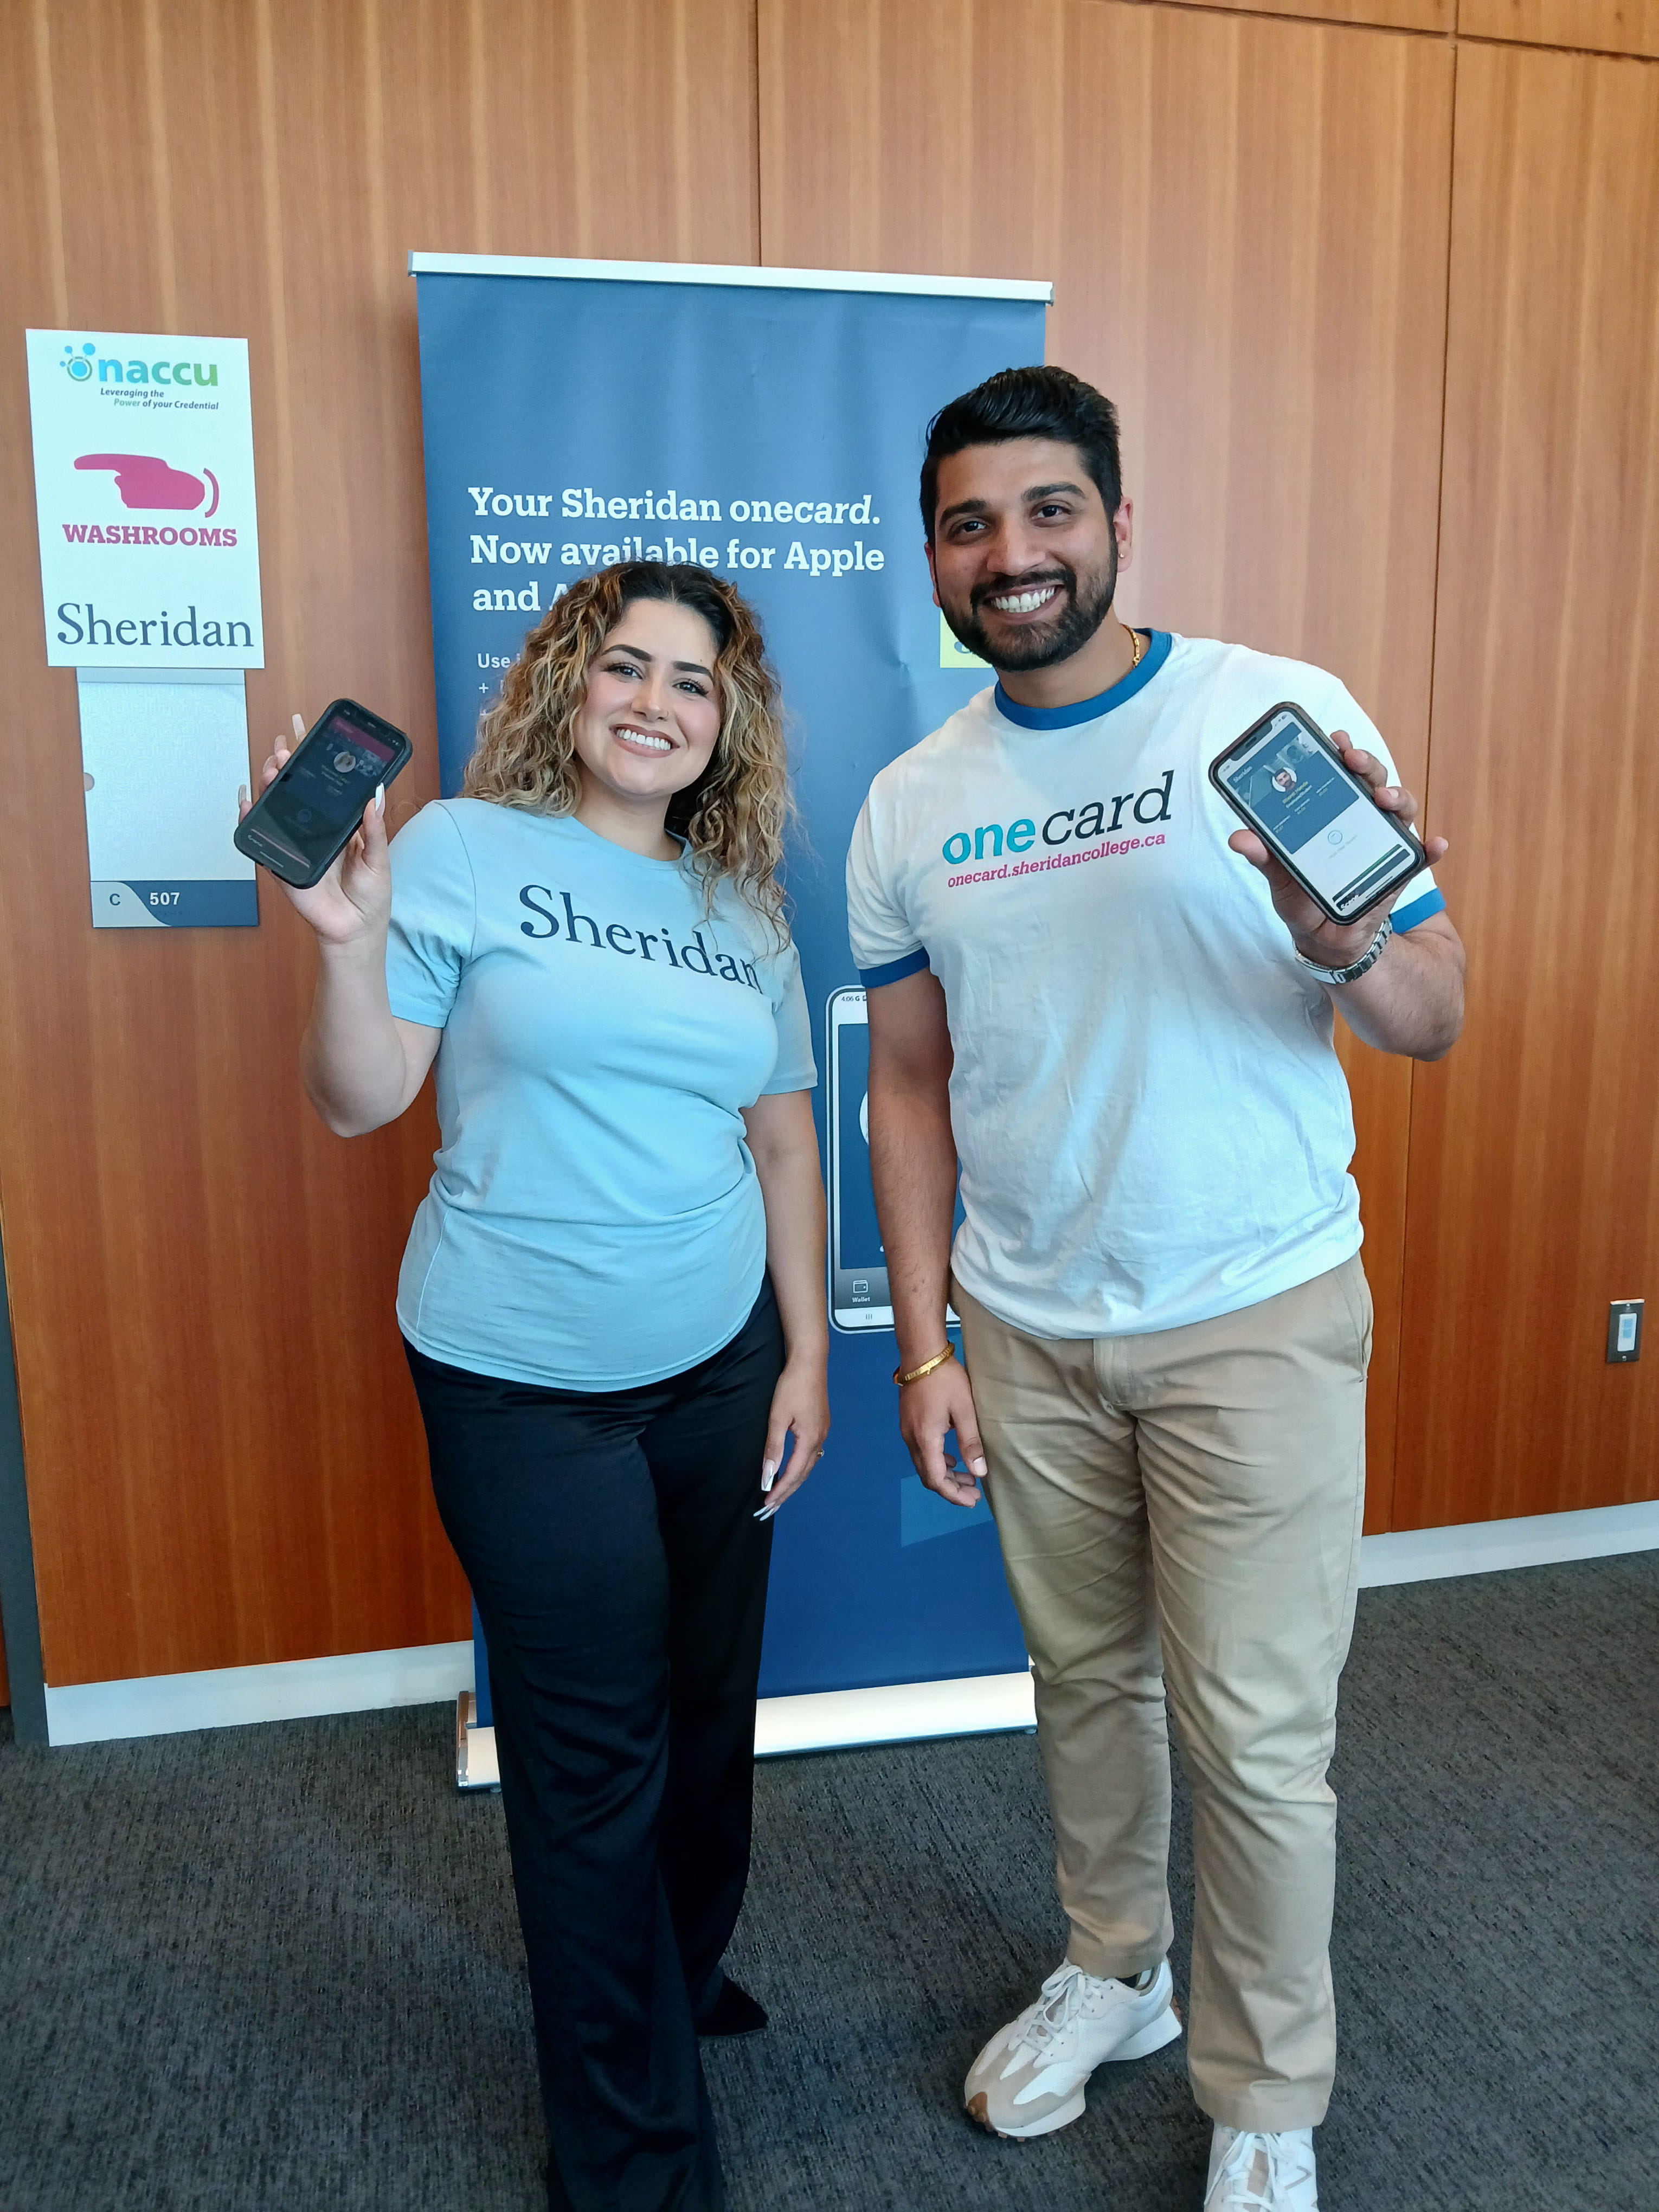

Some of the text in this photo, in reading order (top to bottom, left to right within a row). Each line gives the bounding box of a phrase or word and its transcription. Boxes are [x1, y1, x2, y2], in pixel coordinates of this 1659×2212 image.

[98, 359, 218, 387] naccu
[101, 388, 165, 398] Leveraging the
[114, 398, 141, 407] Power
[143, 399, 152, 407] of
[174, 401, 219, 410] Credential
[467, 487, 880, 525] Your Sheridan onecard.
[62, 524, 238, 547] WASHROOMS
[469, 535, 885, 577] Now available for Apple
[472, 581, 541, 612] and
[57, 602, 254, 647] Sheridan
[477, 652, 511, 668] Use
[942, 769, 1175, 865] onecard
[947, 833, 1166, 888] onecard.sheridancollege.ca
[109, 892, 181, 906] C 507
[519, 884, 763, 995] Sheridan
